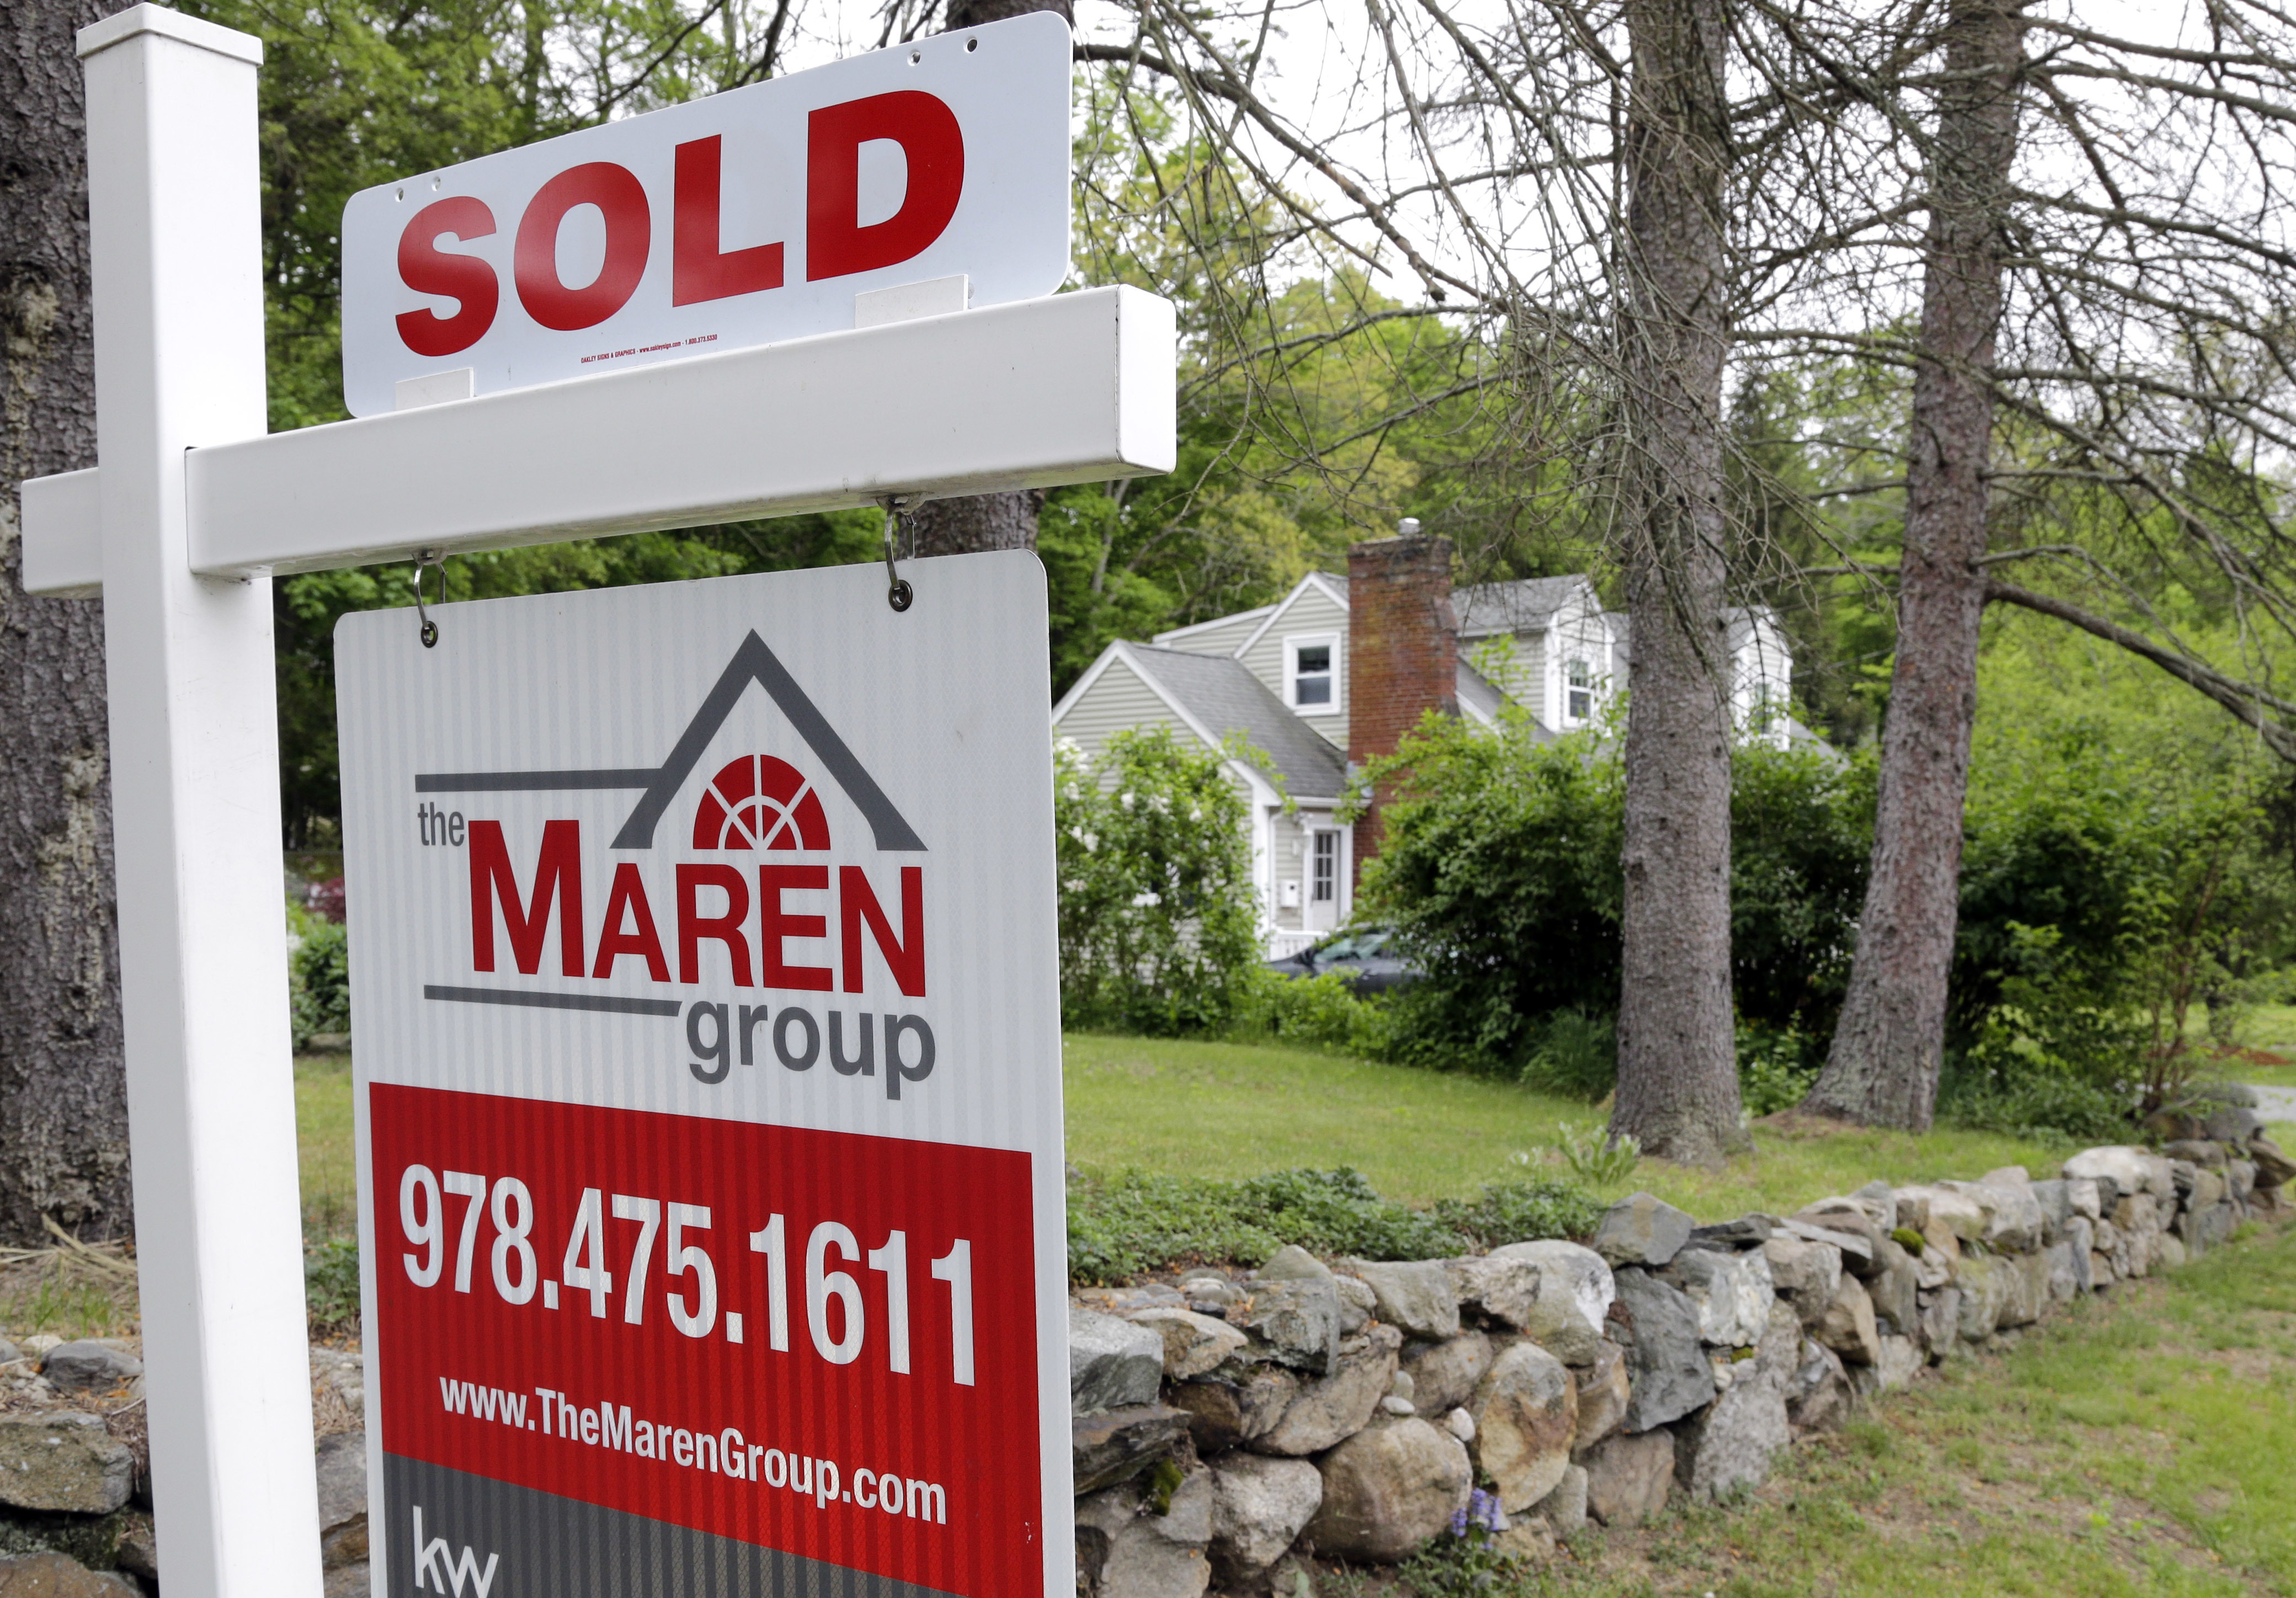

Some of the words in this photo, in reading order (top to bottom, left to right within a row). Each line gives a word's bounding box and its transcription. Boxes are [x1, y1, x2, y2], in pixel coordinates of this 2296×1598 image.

[396, 89, 965, 357] SOLD
[581, 355, 596, 363] OAKLEY
[615, 348, 636, 358] GRAPHICS
[417, 801, 465, 848] the
[468, 819, 926, 998] MAREN
[686, 1000, 936, 1101] group
[399, 1163, 975, 1387] 978.475.1611
[439, 1376, 947, 1525] www.TheMarenGroup.com
[412, 1505, 500, 1598] kw
